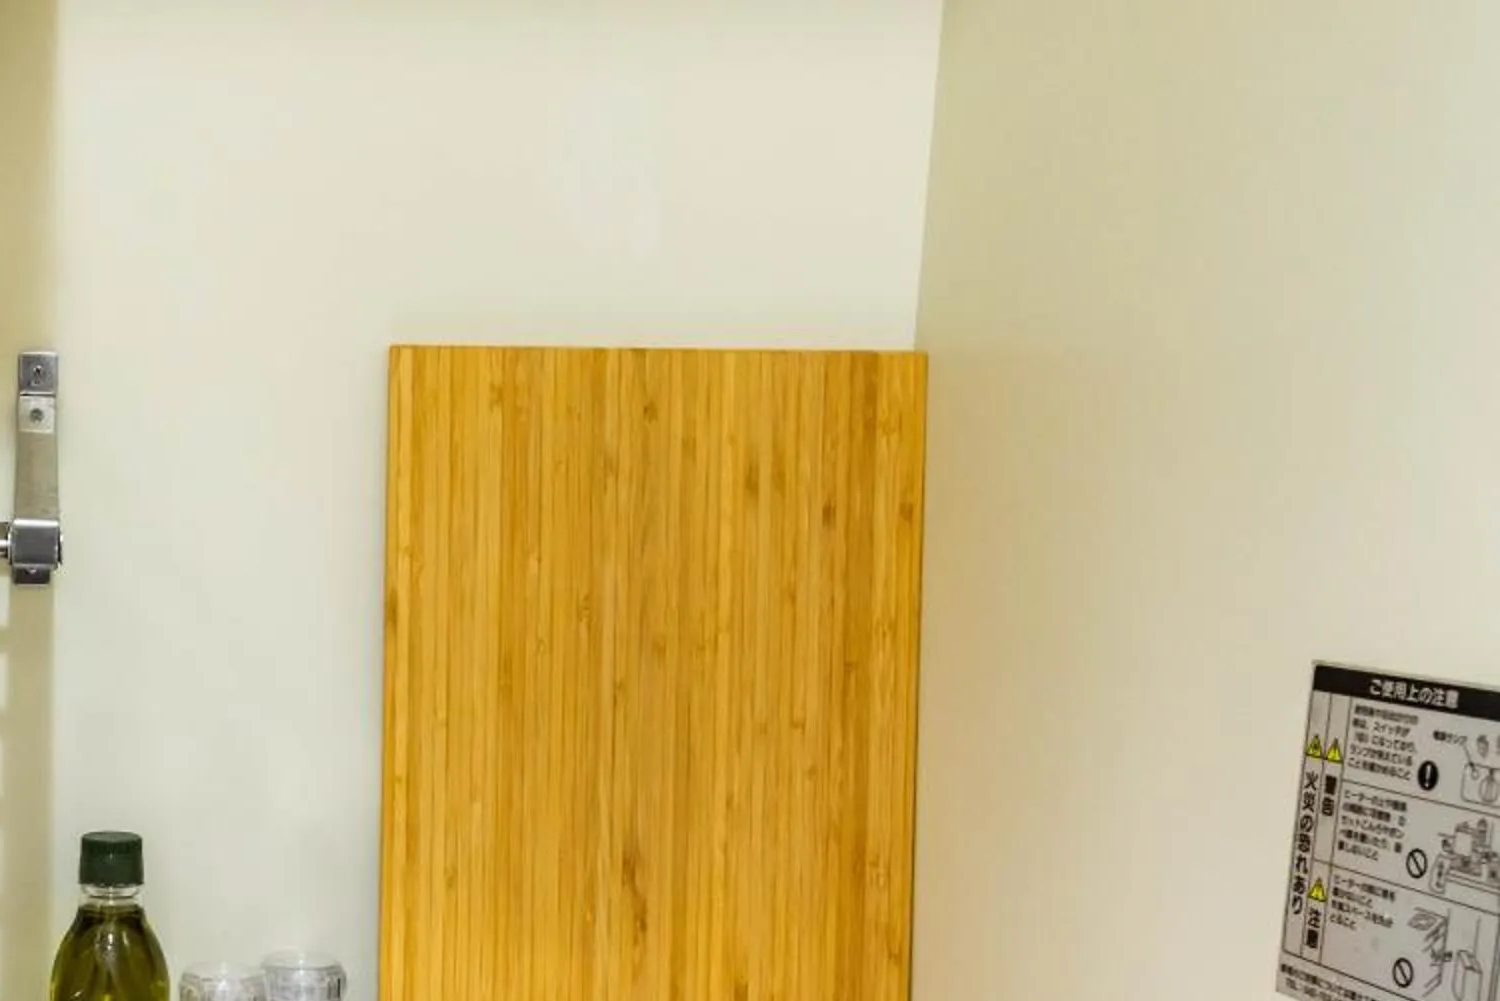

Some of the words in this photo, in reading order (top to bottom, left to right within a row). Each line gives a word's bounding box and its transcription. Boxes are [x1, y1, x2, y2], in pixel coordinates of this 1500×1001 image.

[1369, 679, 1459, 709] ご使用上の注意
